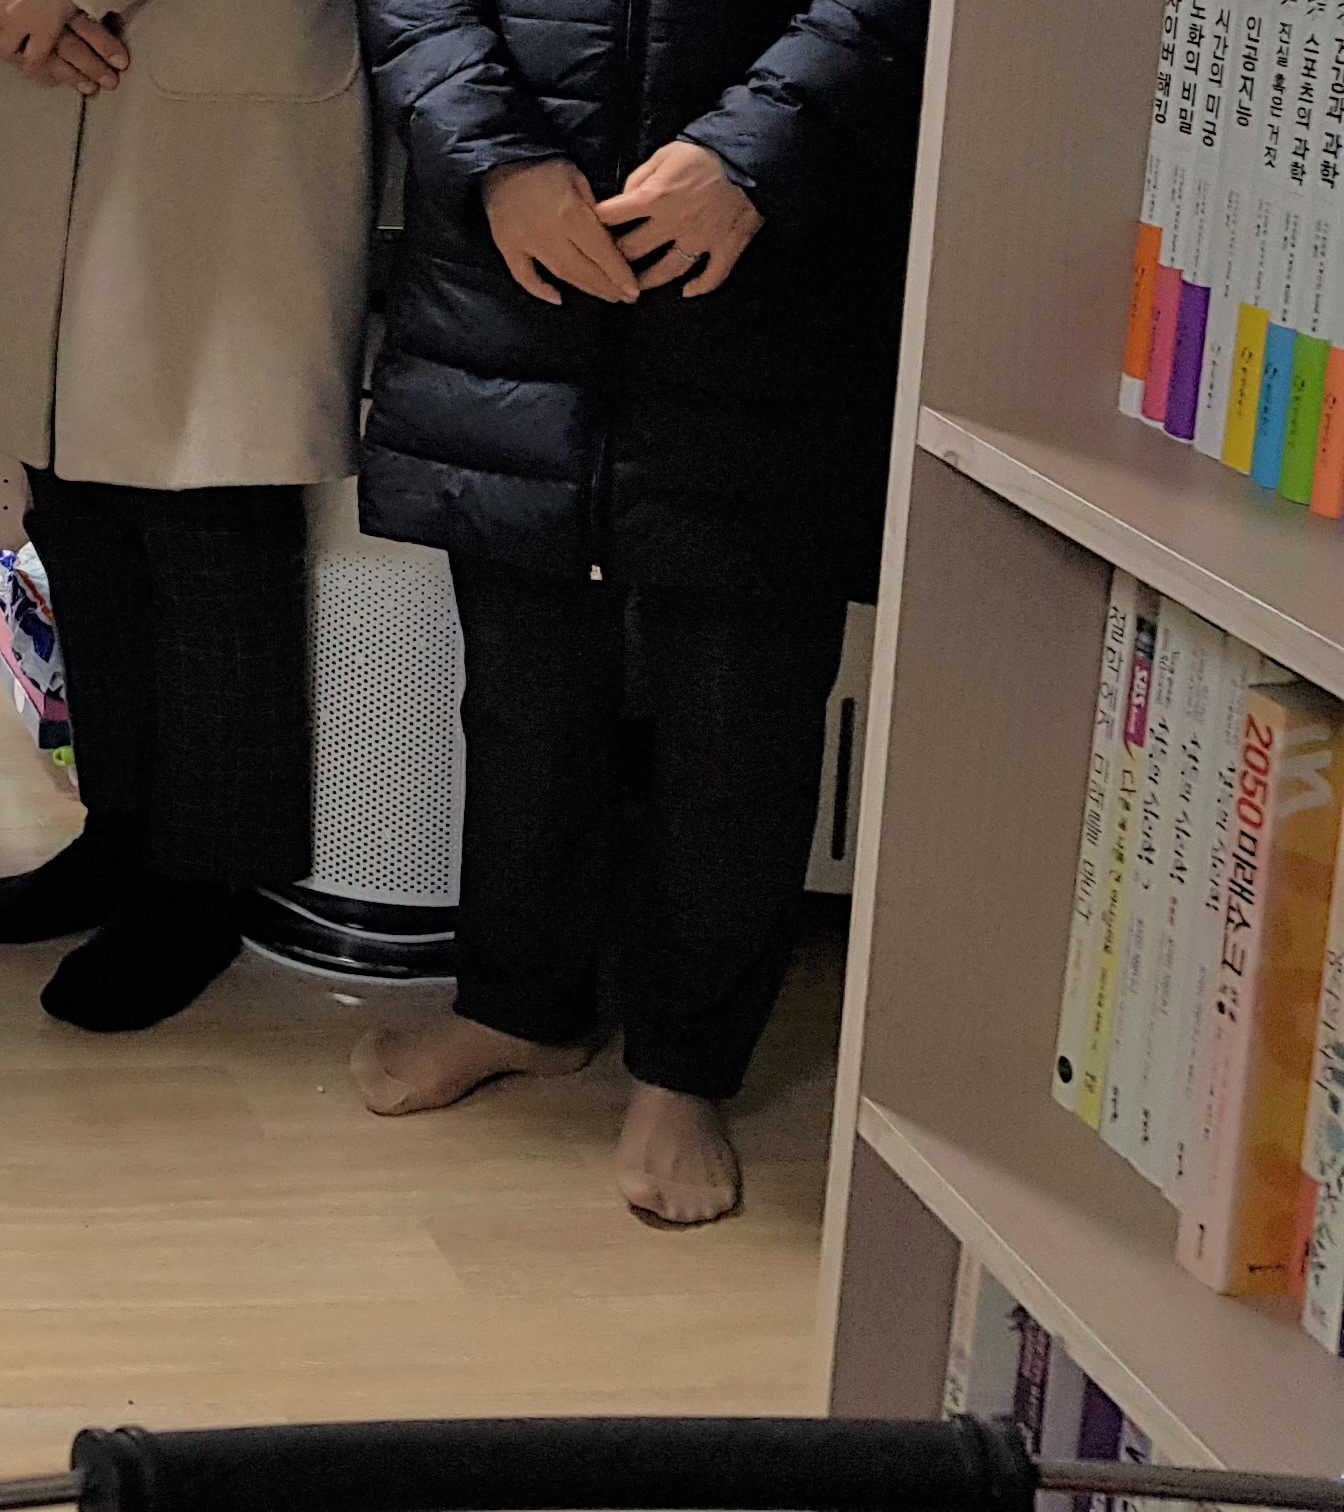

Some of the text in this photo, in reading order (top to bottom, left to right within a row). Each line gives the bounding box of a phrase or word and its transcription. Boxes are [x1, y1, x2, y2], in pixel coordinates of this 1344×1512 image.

[1154, 71, 1172, 125] 해킹
[1178, 80, 1198, 136] 비밀
[1202, 8, 1231, 148] 시간의 미궁
[1235, 15, 1262, 127] 인공지능
[1263, 21, 1293, 169] 진실 혹은 거짓
[1289, 32, 1320, 187] 스포츠의 과학
[1320, 130, 1343, 190] 과학
[1222, 713, 1273, 977] 2050 미래쇼크
